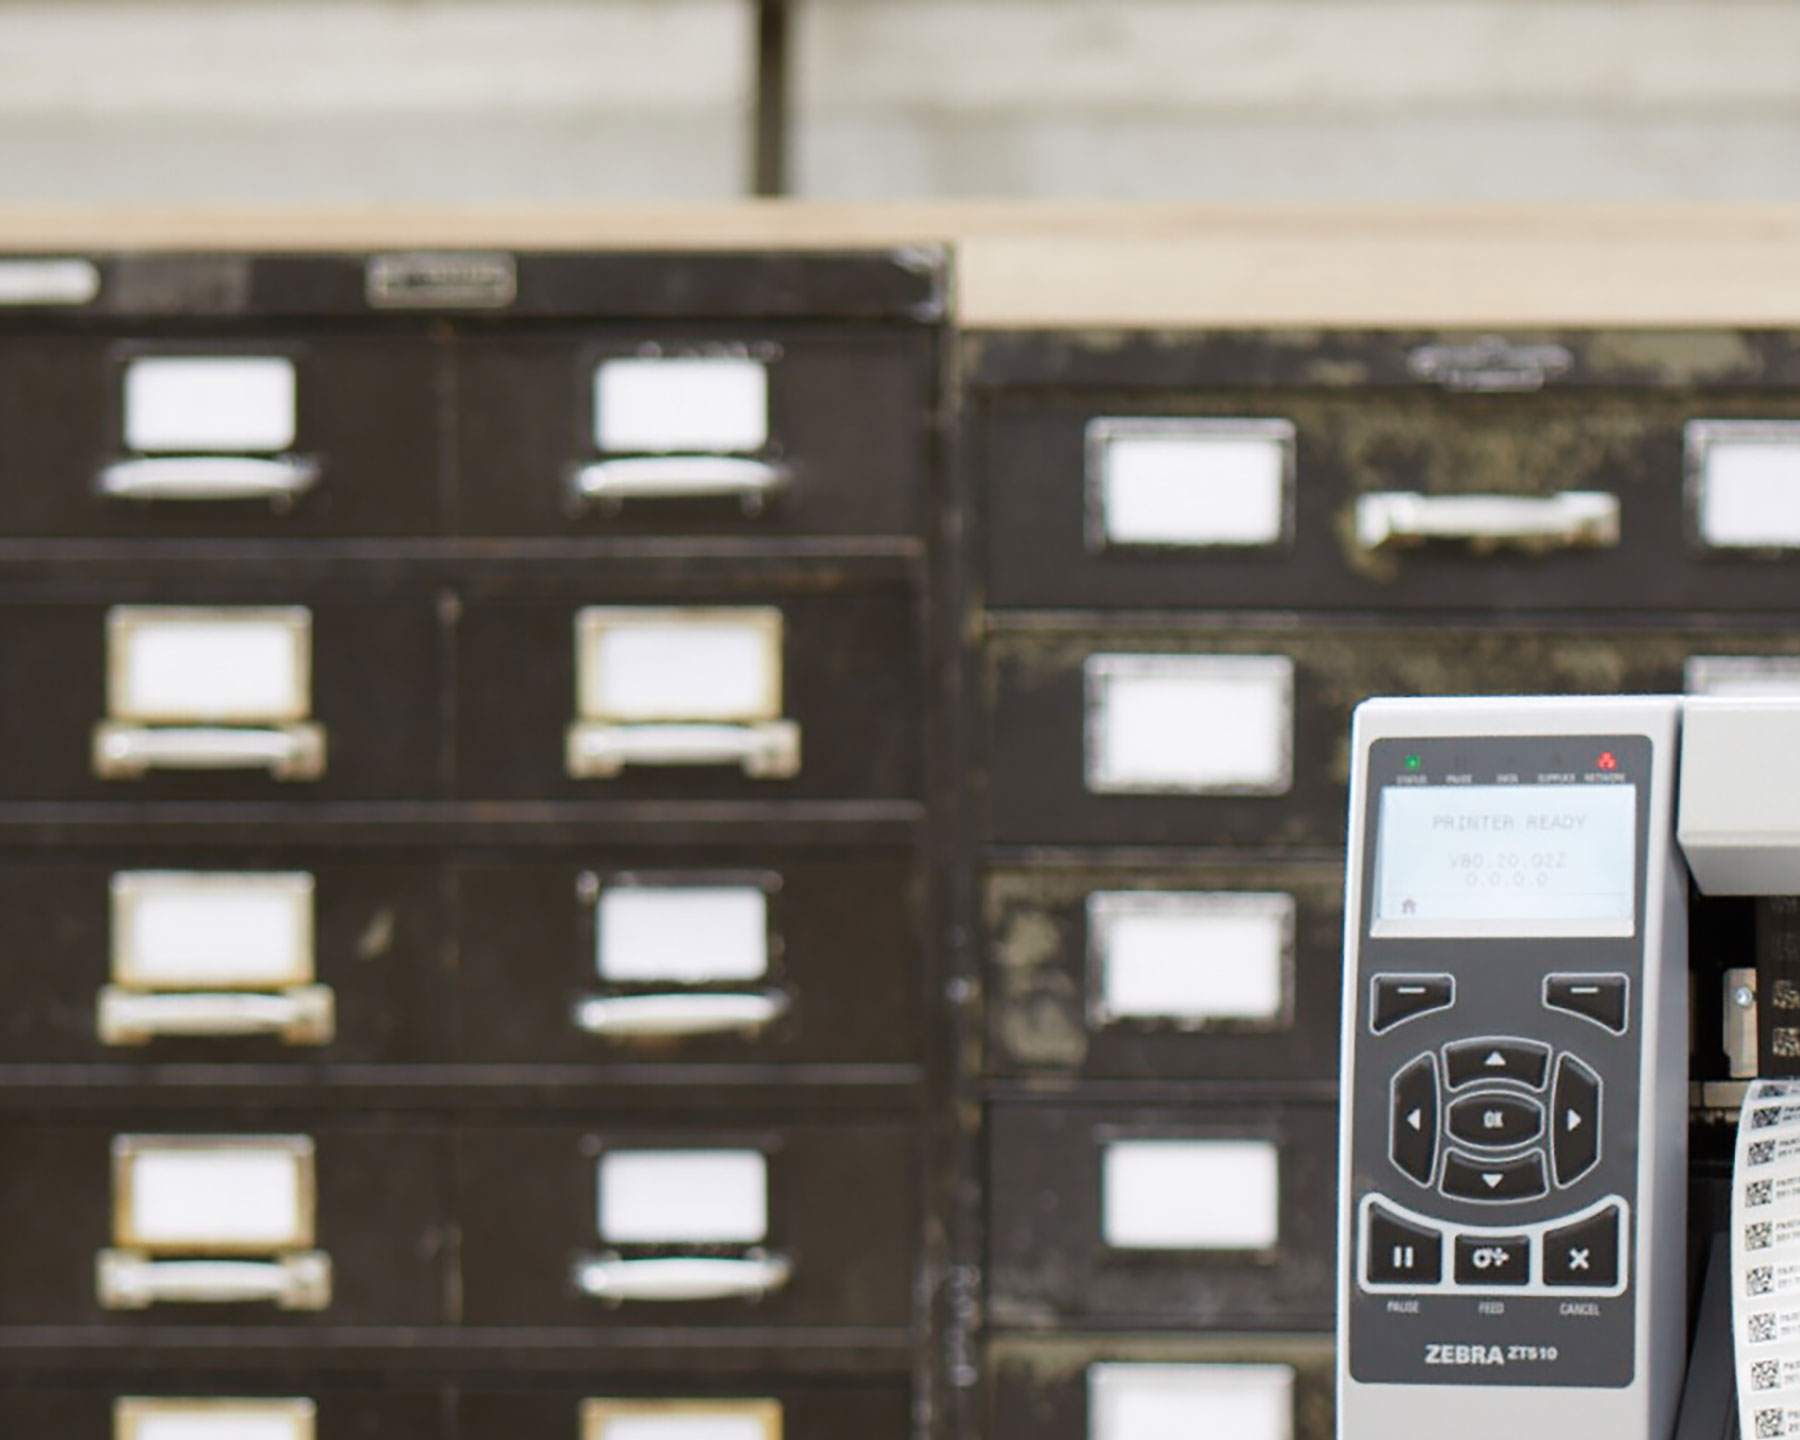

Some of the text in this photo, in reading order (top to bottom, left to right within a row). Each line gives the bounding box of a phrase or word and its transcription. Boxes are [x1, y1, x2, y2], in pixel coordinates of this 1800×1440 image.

[1432, 814, 1588, 831] PRINTER READY
[1483, 1110, 1504, 1128] OK
[1387, 1300, 1419, 1314] PAUSE
[1478, 1301, 1505, 1315] FEED
[1559, 1301, 1601, 1316] CANCEL
[1424, 1343, 1558, 1365] ZEBRA ZT510
